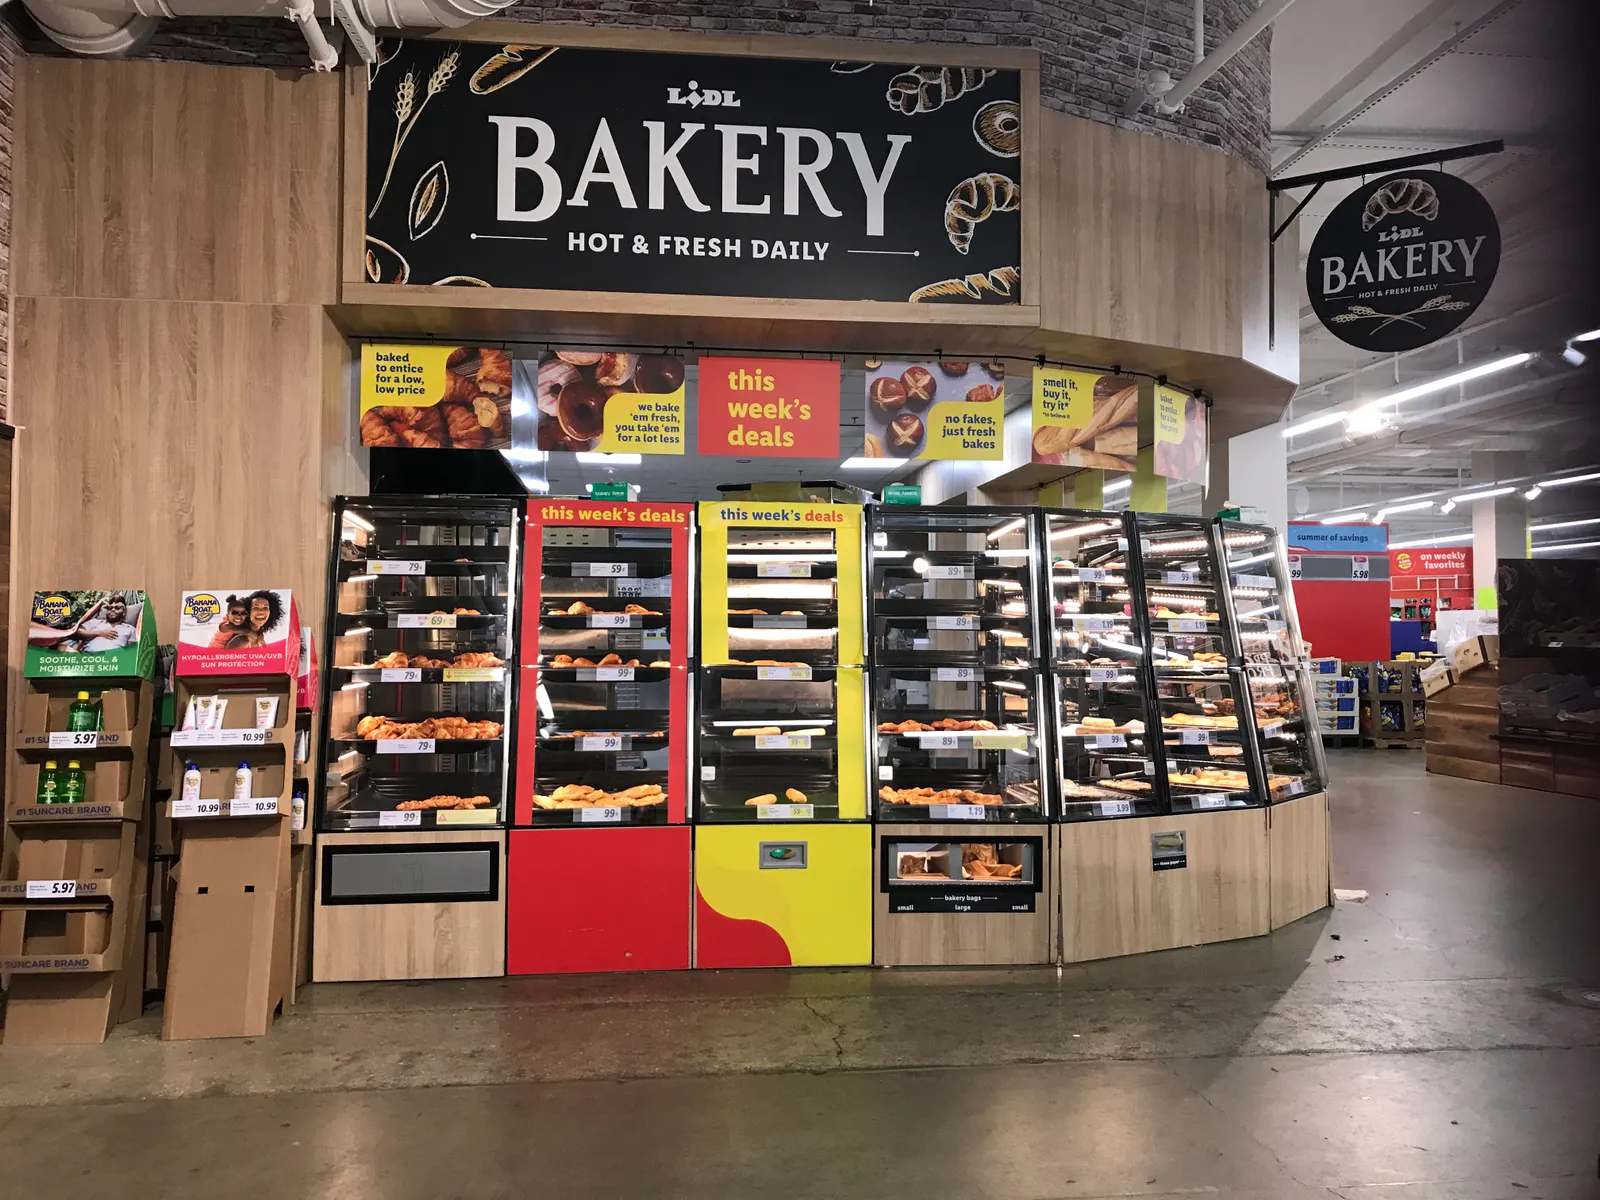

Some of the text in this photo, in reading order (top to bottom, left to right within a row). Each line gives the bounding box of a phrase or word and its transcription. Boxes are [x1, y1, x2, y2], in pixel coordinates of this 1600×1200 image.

[488, 115, 912, 237] BAKERY
[568, 231, 830, 261] HOT & FRESH DAILY
[1321, 235, 1486, 295] BAKERY
[1358, 283, 1439, 299] HOT & FRESH DAILY
[375, 352, 410, 363] baked
[375, 363, 424, 374] to entice
[375, 373, 425, 385] for a low,
[728, 368, 775, 391] this
[1043, 378, 1078, 391] smell it,
[375, 384, 426, 396] low price
[1042, 389, 1071, 401] buy it,
[638, 402, 680, 412] we bake
[727, 398, 812, 420] week's
[1042, 400, 1056, 411] try
[650, 412, 681, 424] fresh,
[945, 413, 996, 426] no fakes,
[615, 423, 634, 434] you
[637, 422, 660, 432] take
[942, 425, 996, 438] just fresh
[617, 432, 680, 444] for a lot less
[727, 424, 795, 447] deals
[962, 438, 995, 449] bakes
[541, 506, 685, 523] this week's deals
[721, 508, 843, 523] this week's deals
[1330, 533, 1338, 541] of
[1340, 534, 1369, 543] savings
[1420, 553, 1432, 561] on
[1434, 551, 1466, 561] weekly
[1424, 560, 1466, 570] favorites
[1353, 570, 1369, 579] 5.98
[40, 599, 69, 608] BANANA
[188, 598, 217, 607] BANANA
[1102, 620, 1113, 628] 1.19
[1195, 621, 1205, 629] 1.19
[39, 656, 79, 665] SOOTHE,
[82, 656, 109, 664] COOL,
[181, 653, 247, 661] HYPOALLERGENIC
[39, 664, 118, 673] MOISTURIZE SKIN
[24, 736, 35, 744] #1
[74, 733, 96, 744] 5.97
[242, 733, 264, 741] 10.99
[16, 805, 111, 816] #1 SUNCARE BRAND
[197, 804, 219, 813] 10.99
[255, 802, 276, 811] 10.99
[968, 807, 984, 816] 1.19
[1116, 803, 1129, 813] 3.99
[52, 882, 75, 894] 5.97
[944, 895, 981, 903] bakery bags
[955, 904, 971, 912] large
[4, 958, 89, 969] SUNCARE BRAND
